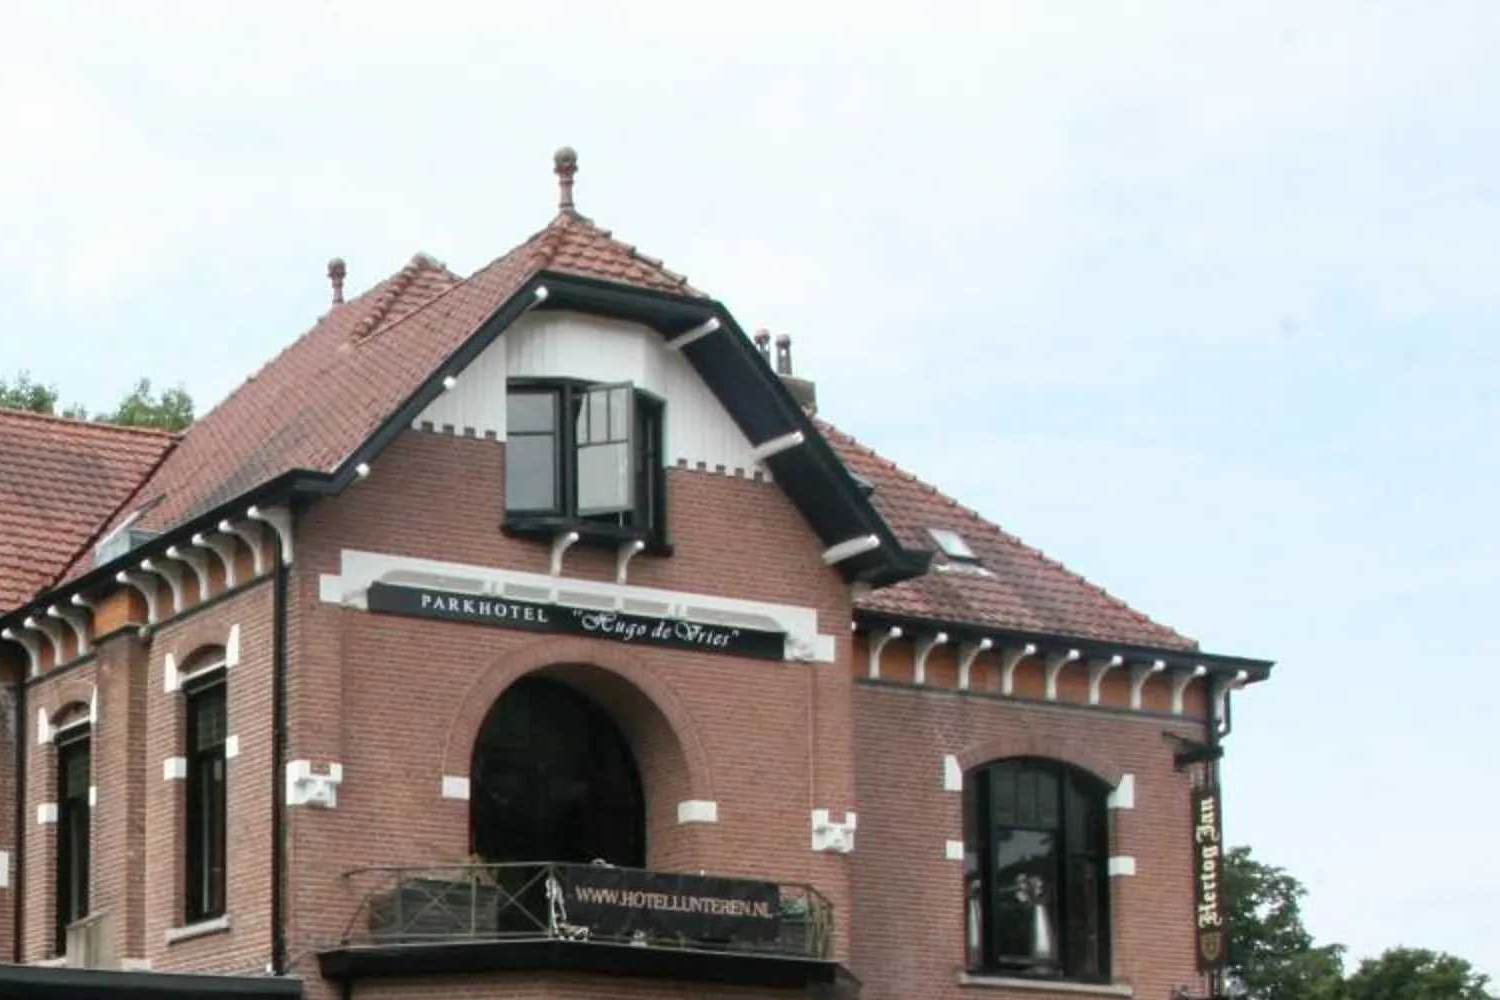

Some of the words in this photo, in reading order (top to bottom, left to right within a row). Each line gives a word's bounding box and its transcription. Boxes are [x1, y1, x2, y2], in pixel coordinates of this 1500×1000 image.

[420, 593, 550, 624] PARKHOTEL
[651, 620, 672, 640] de
[1195, 796, 1221, 843] Jan
[1197, 845, 1222, 929] Hertog
